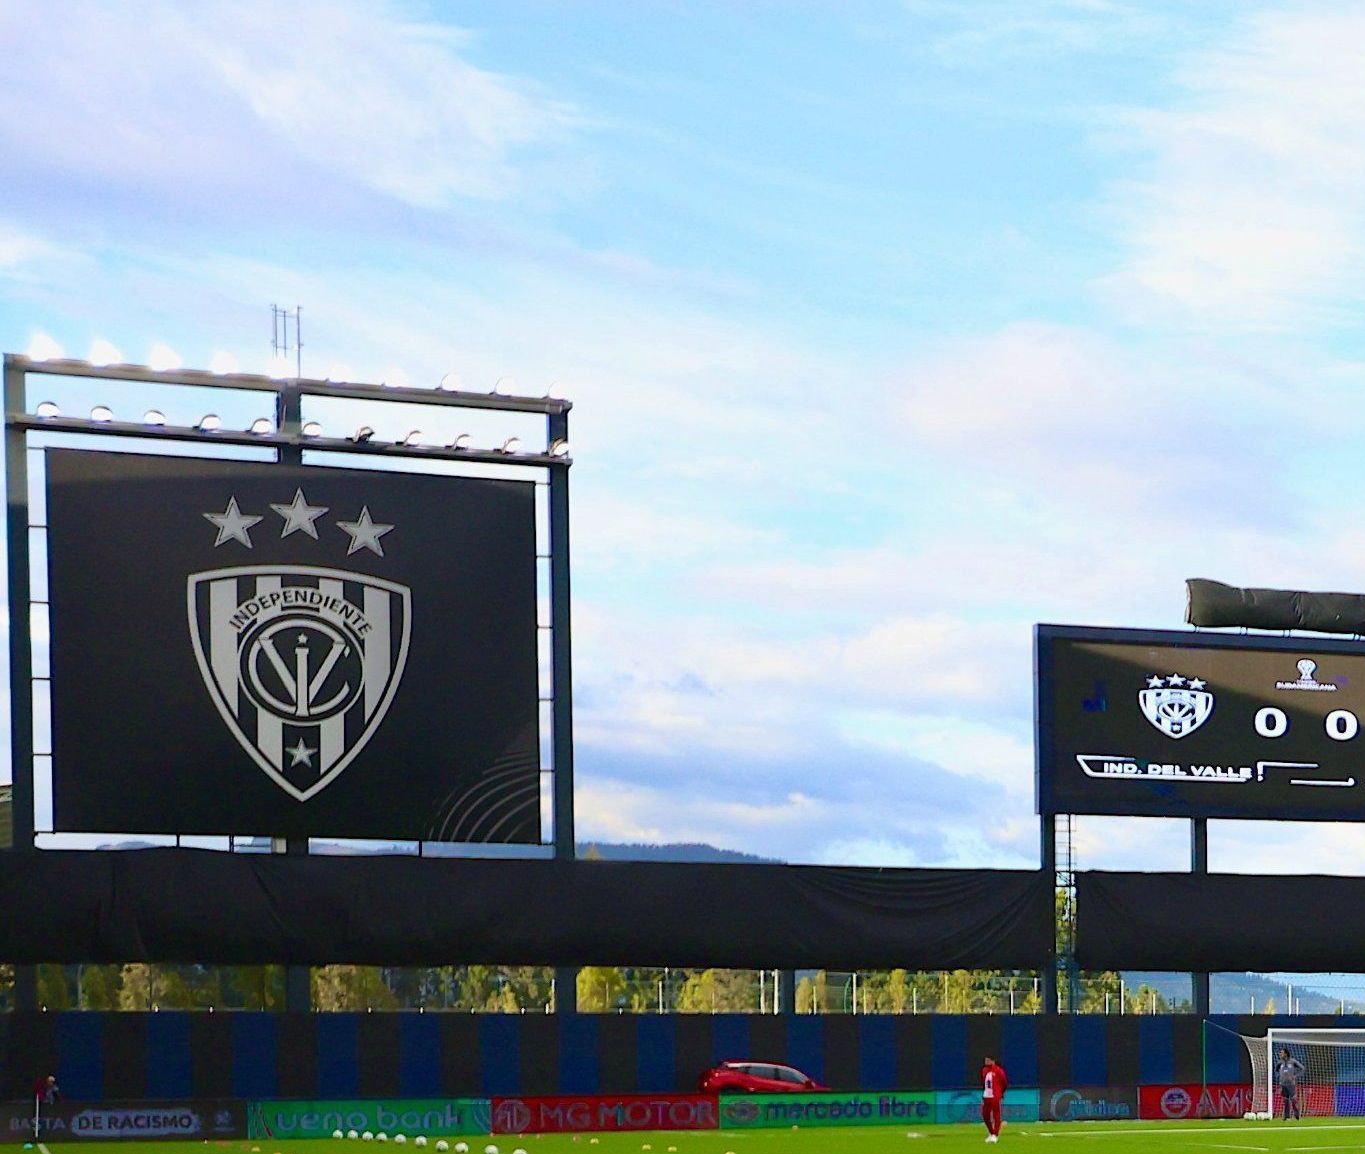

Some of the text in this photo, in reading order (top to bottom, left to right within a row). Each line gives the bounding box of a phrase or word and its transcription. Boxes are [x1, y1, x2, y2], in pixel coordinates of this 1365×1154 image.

[229, 590, 372, 636] INDEPENDIENTE
[1255, 707, 1359, 741] 0 0
[1103, 762, 1253, 779] IND. DEL VALLE
[277, 1103, 462, 1131] ueno bank
[540, 1102, 590, 1129] MG
[600, 1100, 717, 1127] MOTOR
[765, 1095, 930, 1121] mercado libre
[8, 1113, 193, 1132] BASTA DE RACISMO
